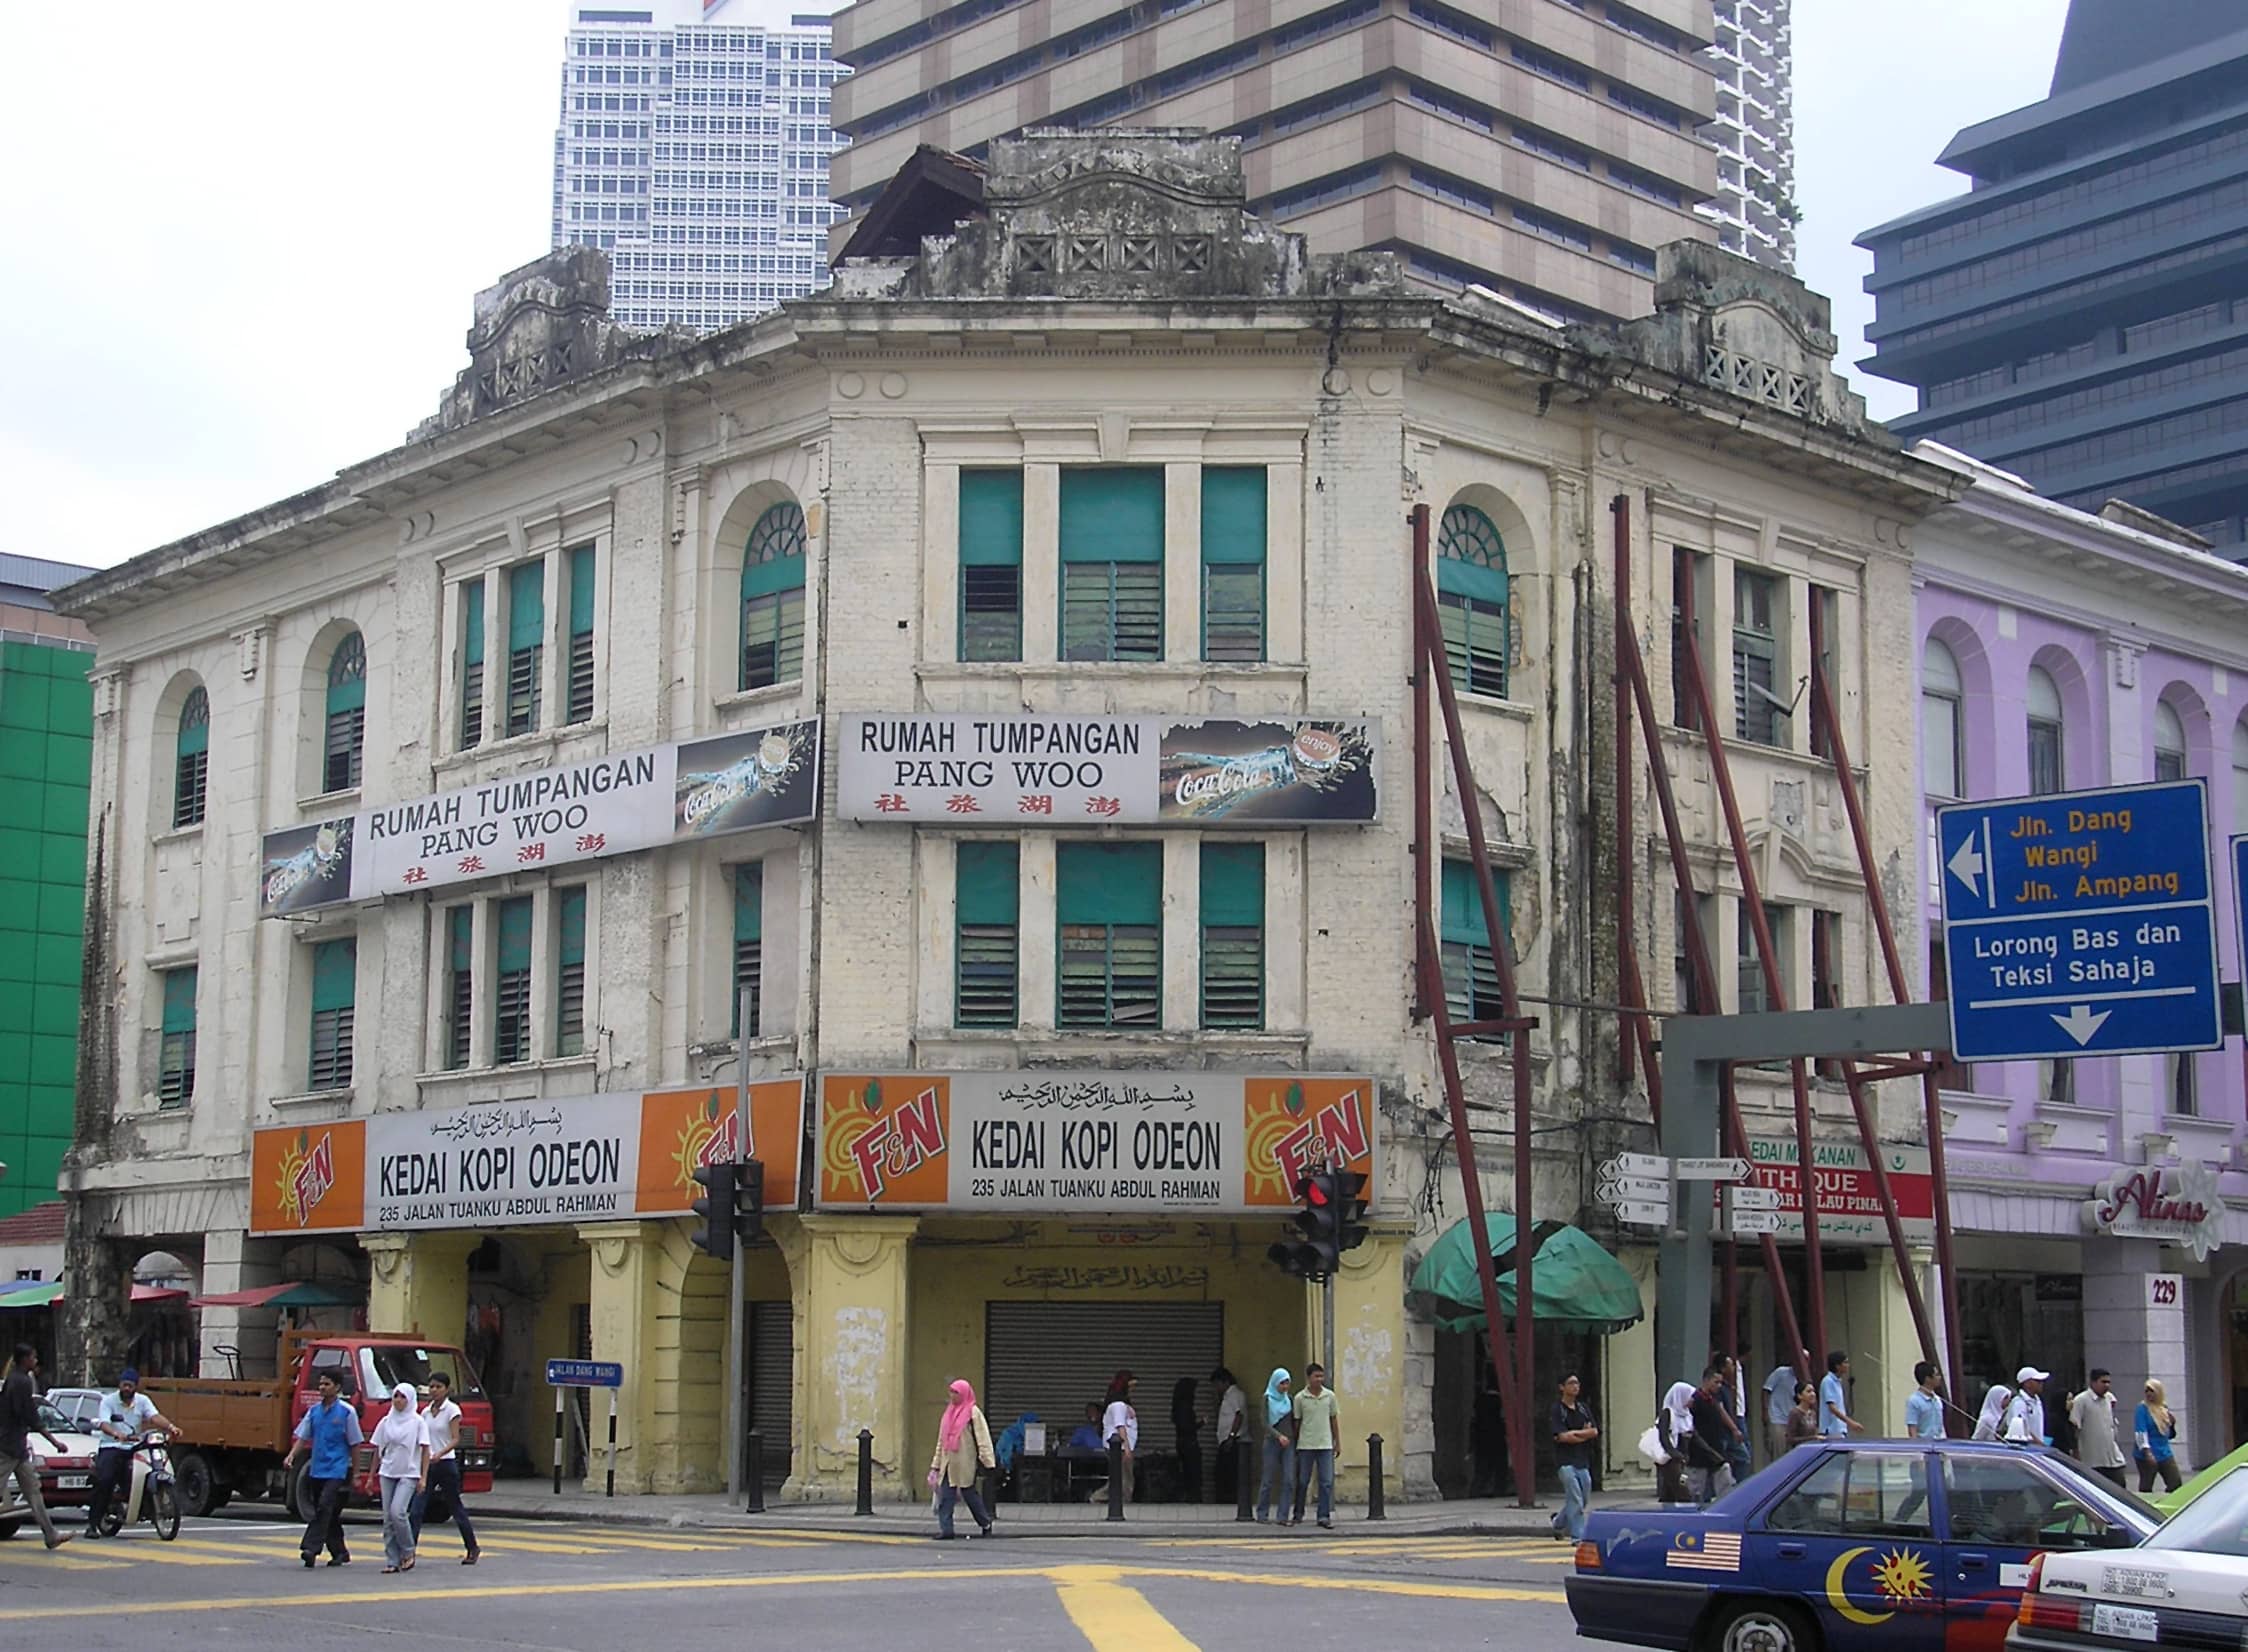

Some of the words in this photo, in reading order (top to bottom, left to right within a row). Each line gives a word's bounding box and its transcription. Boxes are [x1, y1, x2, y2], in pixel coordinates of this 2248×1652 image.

[861, 721, 955, 753] RUMAH
[973, 722, 1139, 755] TUMPANGAN
[1300, 733, 1337, 754] enjoy
[894, 760, 994, 788] PANG
[1011, 761, 1103, 788] WOO
[370, 795, 462, 841] RUMAH
[476, 753, 654, 813] TUMPANGAN
[420, 821, 498, 859] PANG
[512, 804, 588, 840] WOO
[2010, 816, 2052, 839] Jln.
[2068, 809, 2132, 833] Dang
[2025, 842, 2097, 869] Wangi
[2015, 880, 2058, 904] Jln.
[2075, 872, 2179, 898] Ampang
[1974, 935, 2058, 959] Lorong
[2072, 928, 2119, 950] Bas
[2135, 922, 2181, 945] dan
[1990, 962, 2053, 988] Teksi
[2068, 955, 2155, 985] Sahaja
[852, 1086, 947, 1203] F&N
[972, 1120, 1045, 1169] KEDAI
[1061, 1120, 1118, 1171] KOPI
[1133, 1120, 1221, 1171] ODEON
[1751, 1141, 1784, 1161] EDAI
[380, 1151, 447, 1198] KEDAI
[459, 1146, 515, 1193] KOPI
[528, 1138, 620, 1189] ODEON
[971, 1178, 995, 1197] 235
[999, 1179, 1045, 1198] JALAN
[1050, 1179, 1106, 1199] TUANKU
[1110, 1179, 1157, 1199] ABDUL
[1161, 1180, 1220, 1199] RAHMAN
[379, 1205, 400, 1222] 235
[403, 1203, 445, 1221] JALAN
[448, 1199, 501, 1219] TUANKU
[505, 1197, 552, 1216] ABDUL
[556, 1193, 617, 1213] RAHMAN
[2153, 1279, 2177, 1305] 229
